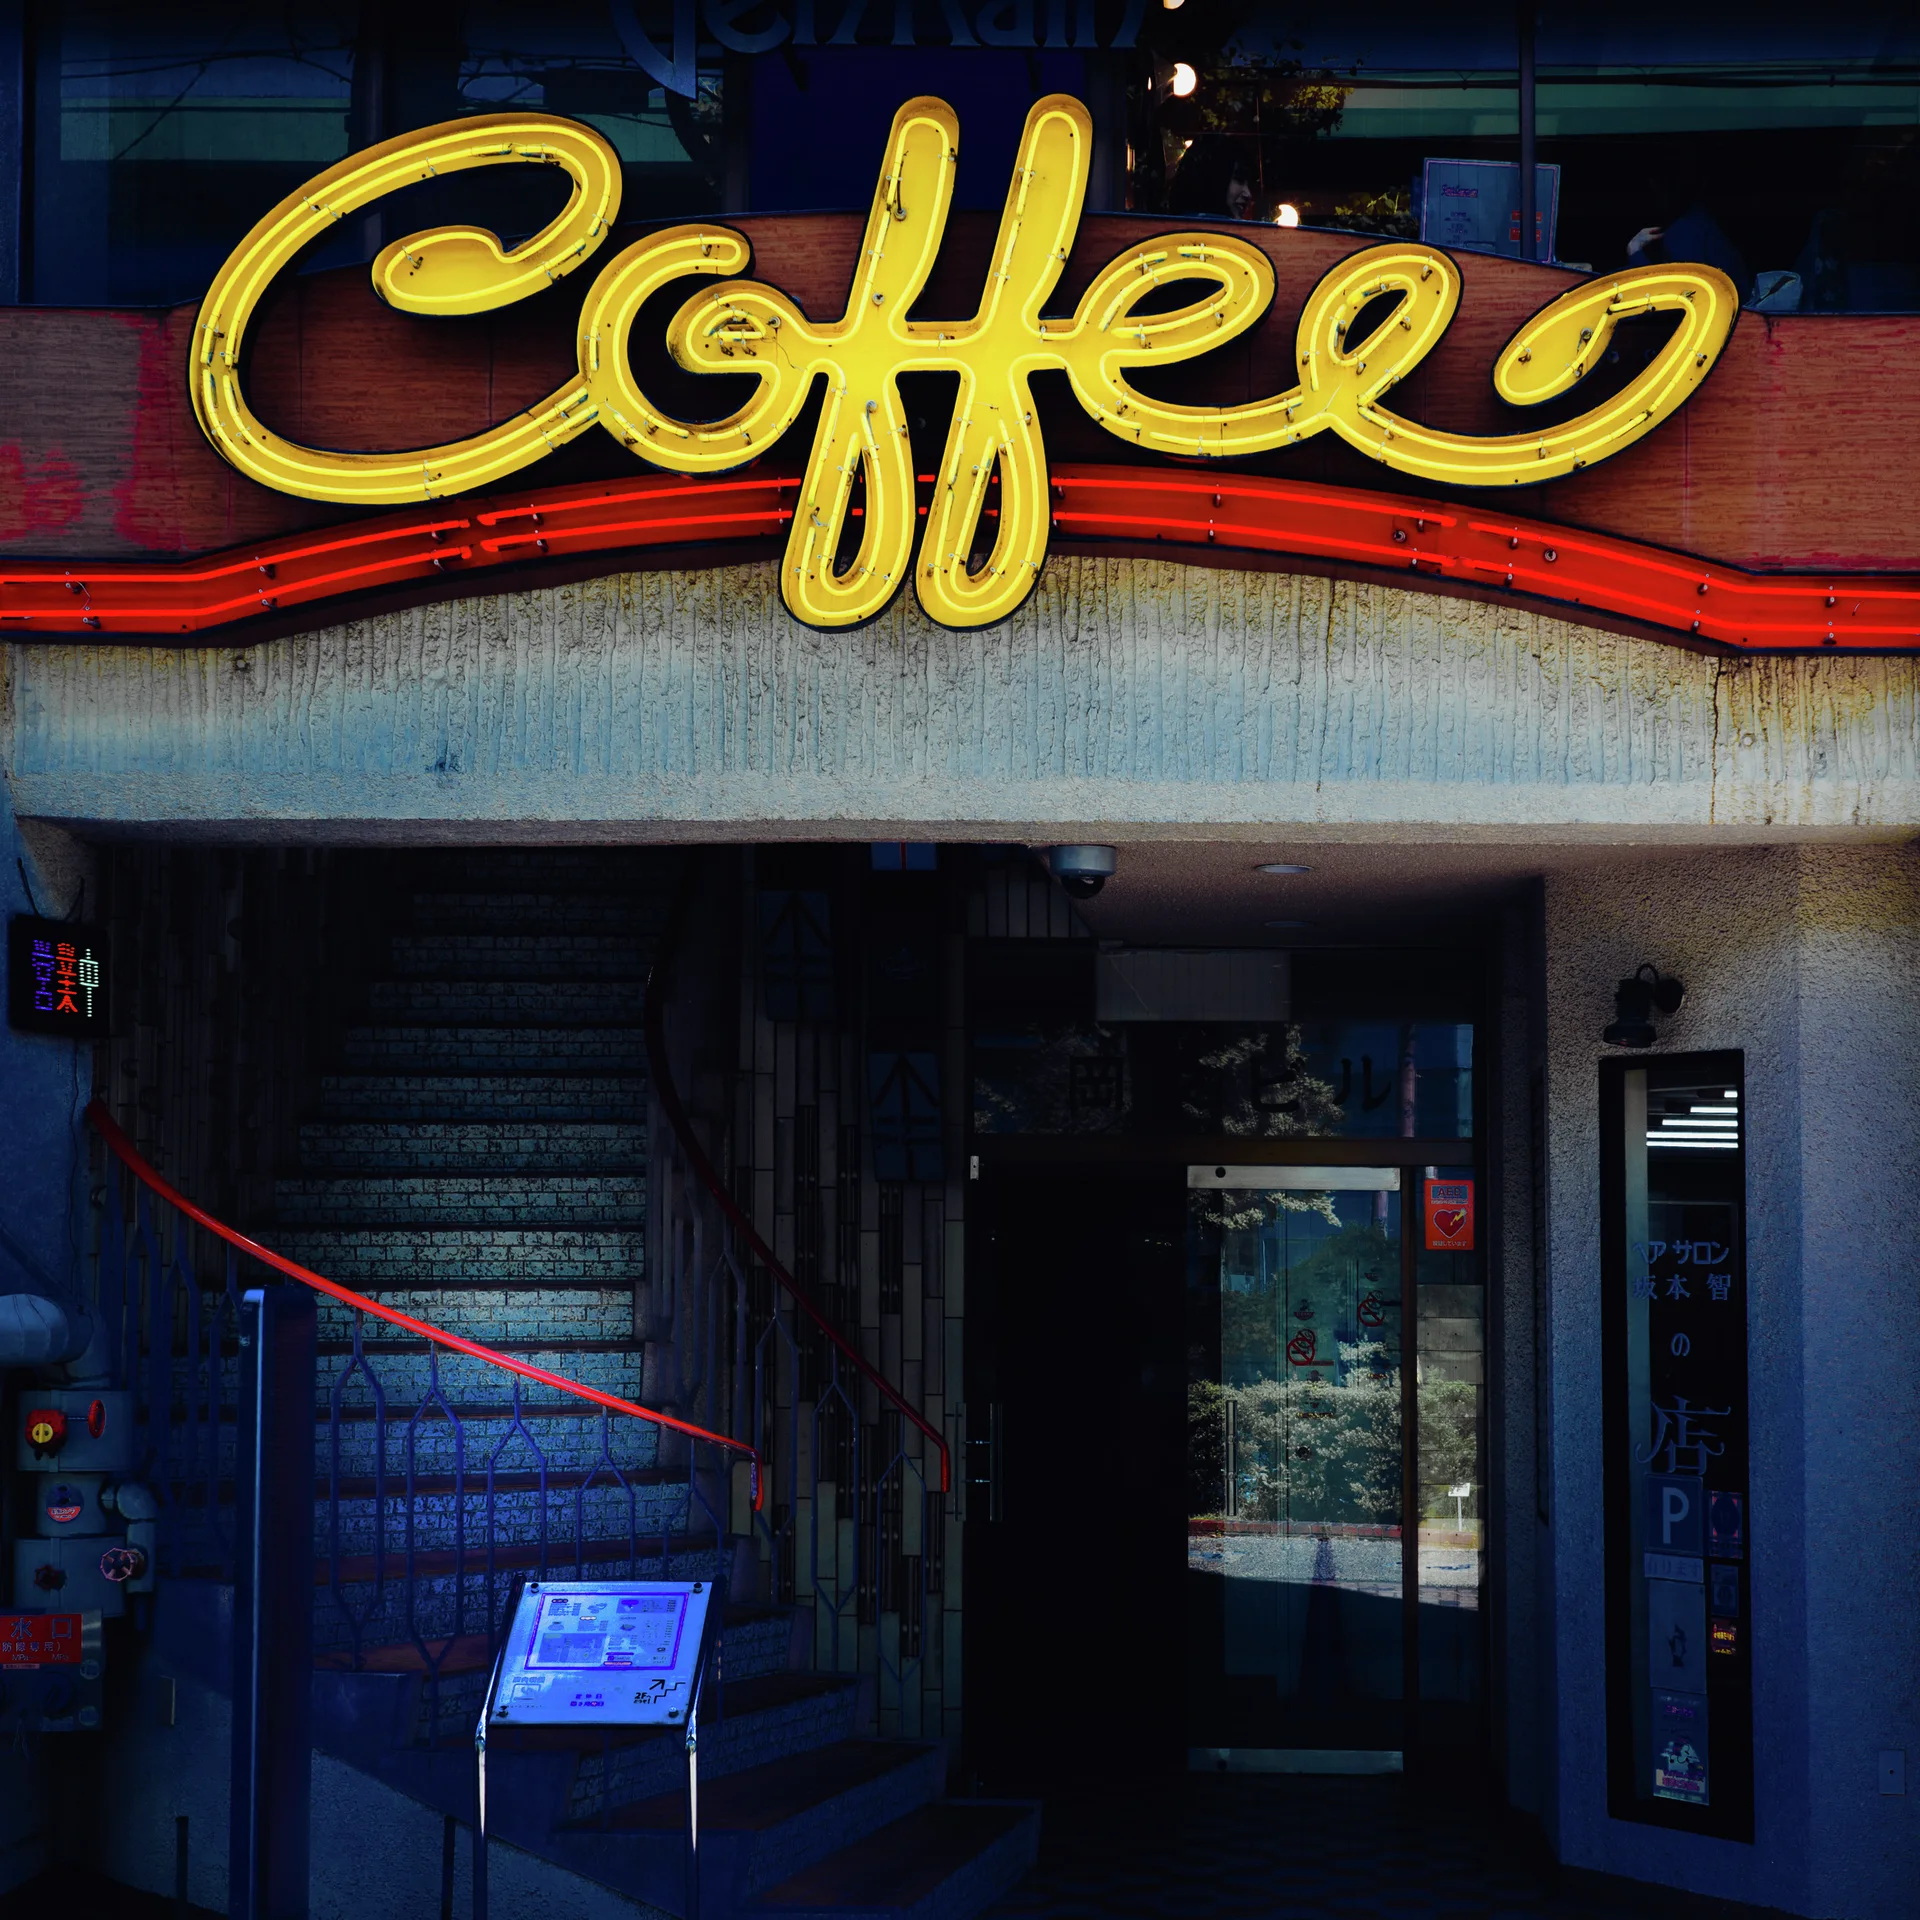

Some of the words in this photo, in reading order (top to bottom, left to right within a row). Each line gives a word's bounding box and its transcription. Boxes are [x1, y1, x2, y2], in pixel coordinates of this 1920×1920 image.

[187, 93, 1741, 630] Coffee
[31, 939, 99, 1018] 営業中
[1438, 1187, 1462, 1196] AED
[1631, 1239, 1730, 1265] ヘアサロン
[1670, 1332, 1691, 1357] の
[1635, 1394, 1732, 1475] 店
[1662, 1486, 1690, 1545] P
[11, 1617, 73, 1640] 水口
